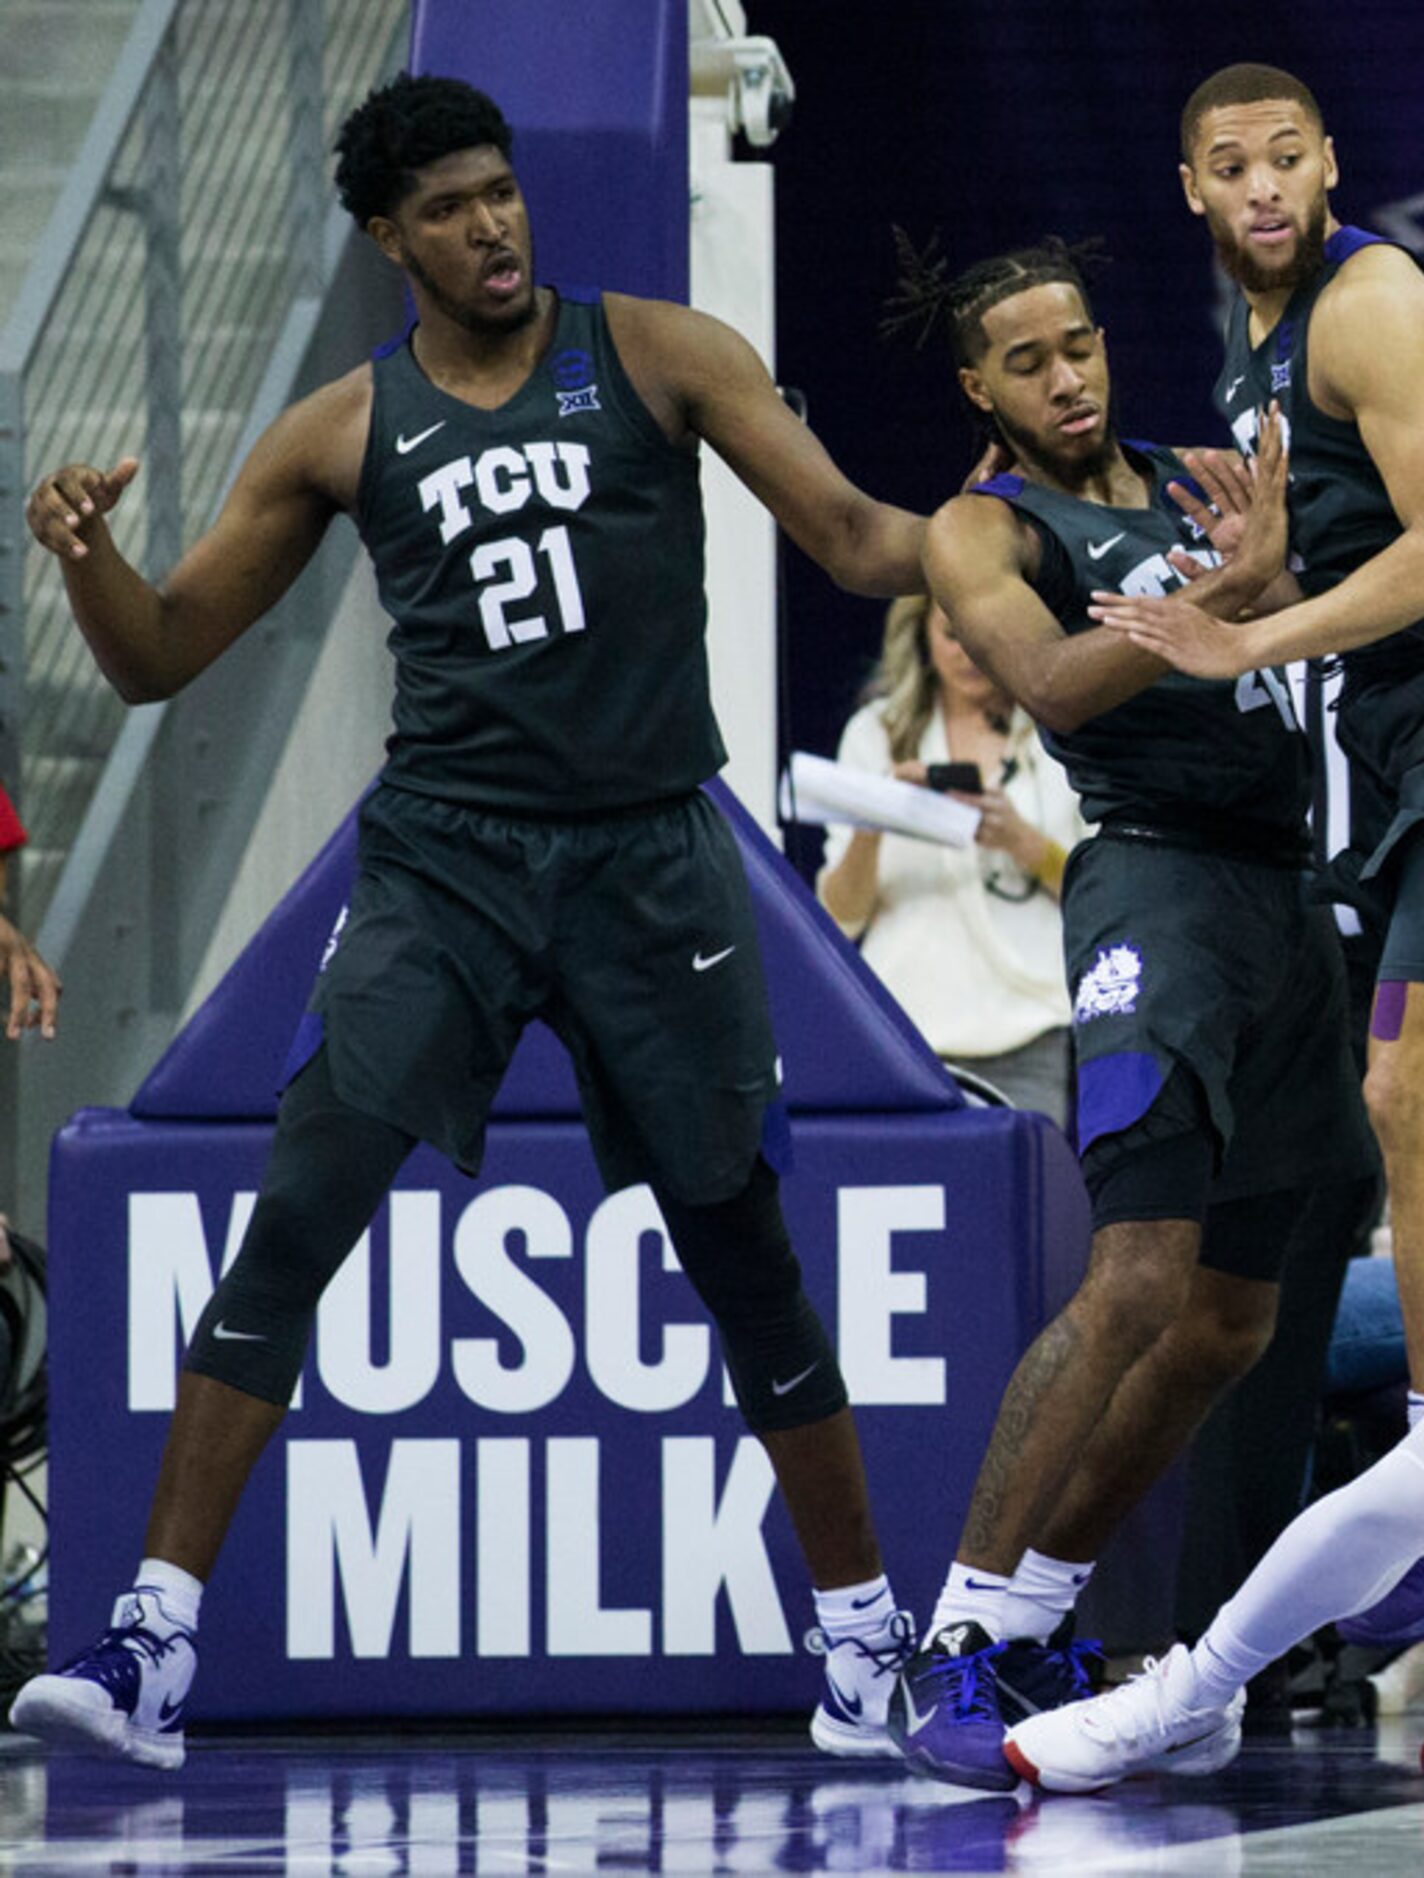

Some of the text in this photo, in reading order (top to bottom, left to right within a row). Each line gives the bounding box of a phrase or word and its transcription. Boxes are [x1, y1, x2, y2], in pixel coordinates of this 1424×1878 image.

[418, 441, 591, 545] TCU
[470, 524, 586, 650] 21
[127, 1185, 947, 1413] MUSCE
[286, 1436, 794, 1660] MILK
